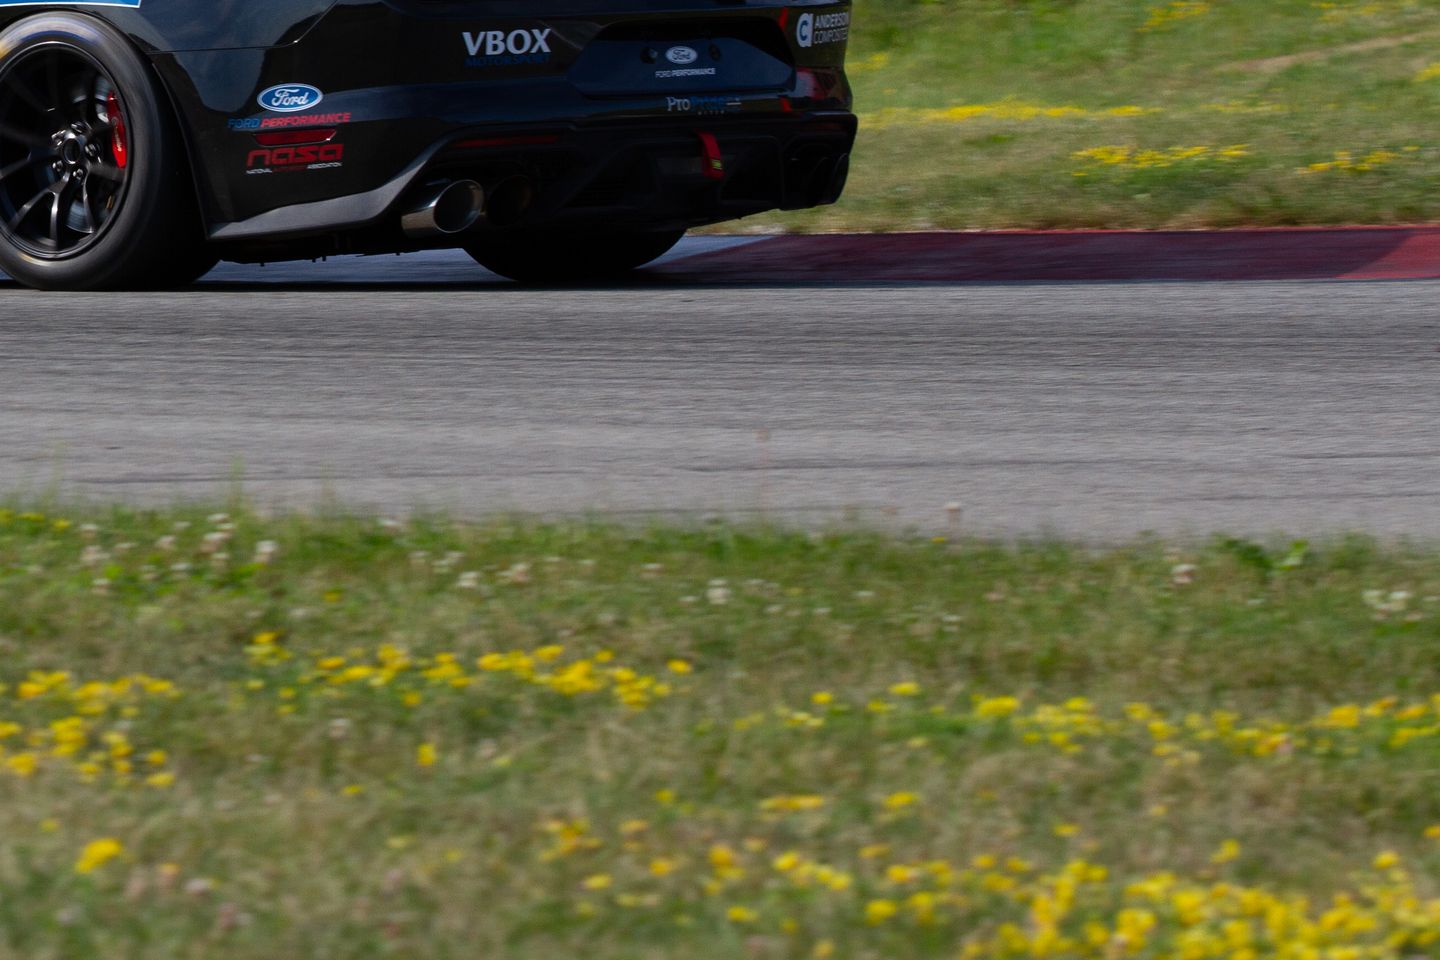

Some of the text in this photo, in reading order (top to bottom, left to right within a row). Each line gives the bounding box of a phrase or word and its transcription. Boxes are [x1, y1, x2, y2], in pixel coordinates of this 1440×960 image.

[462, 28, 552, 56] VBOX
[271, 88, 310, 107] Ford
[227, 112, 352, 129] FORD PERFORMANCE
